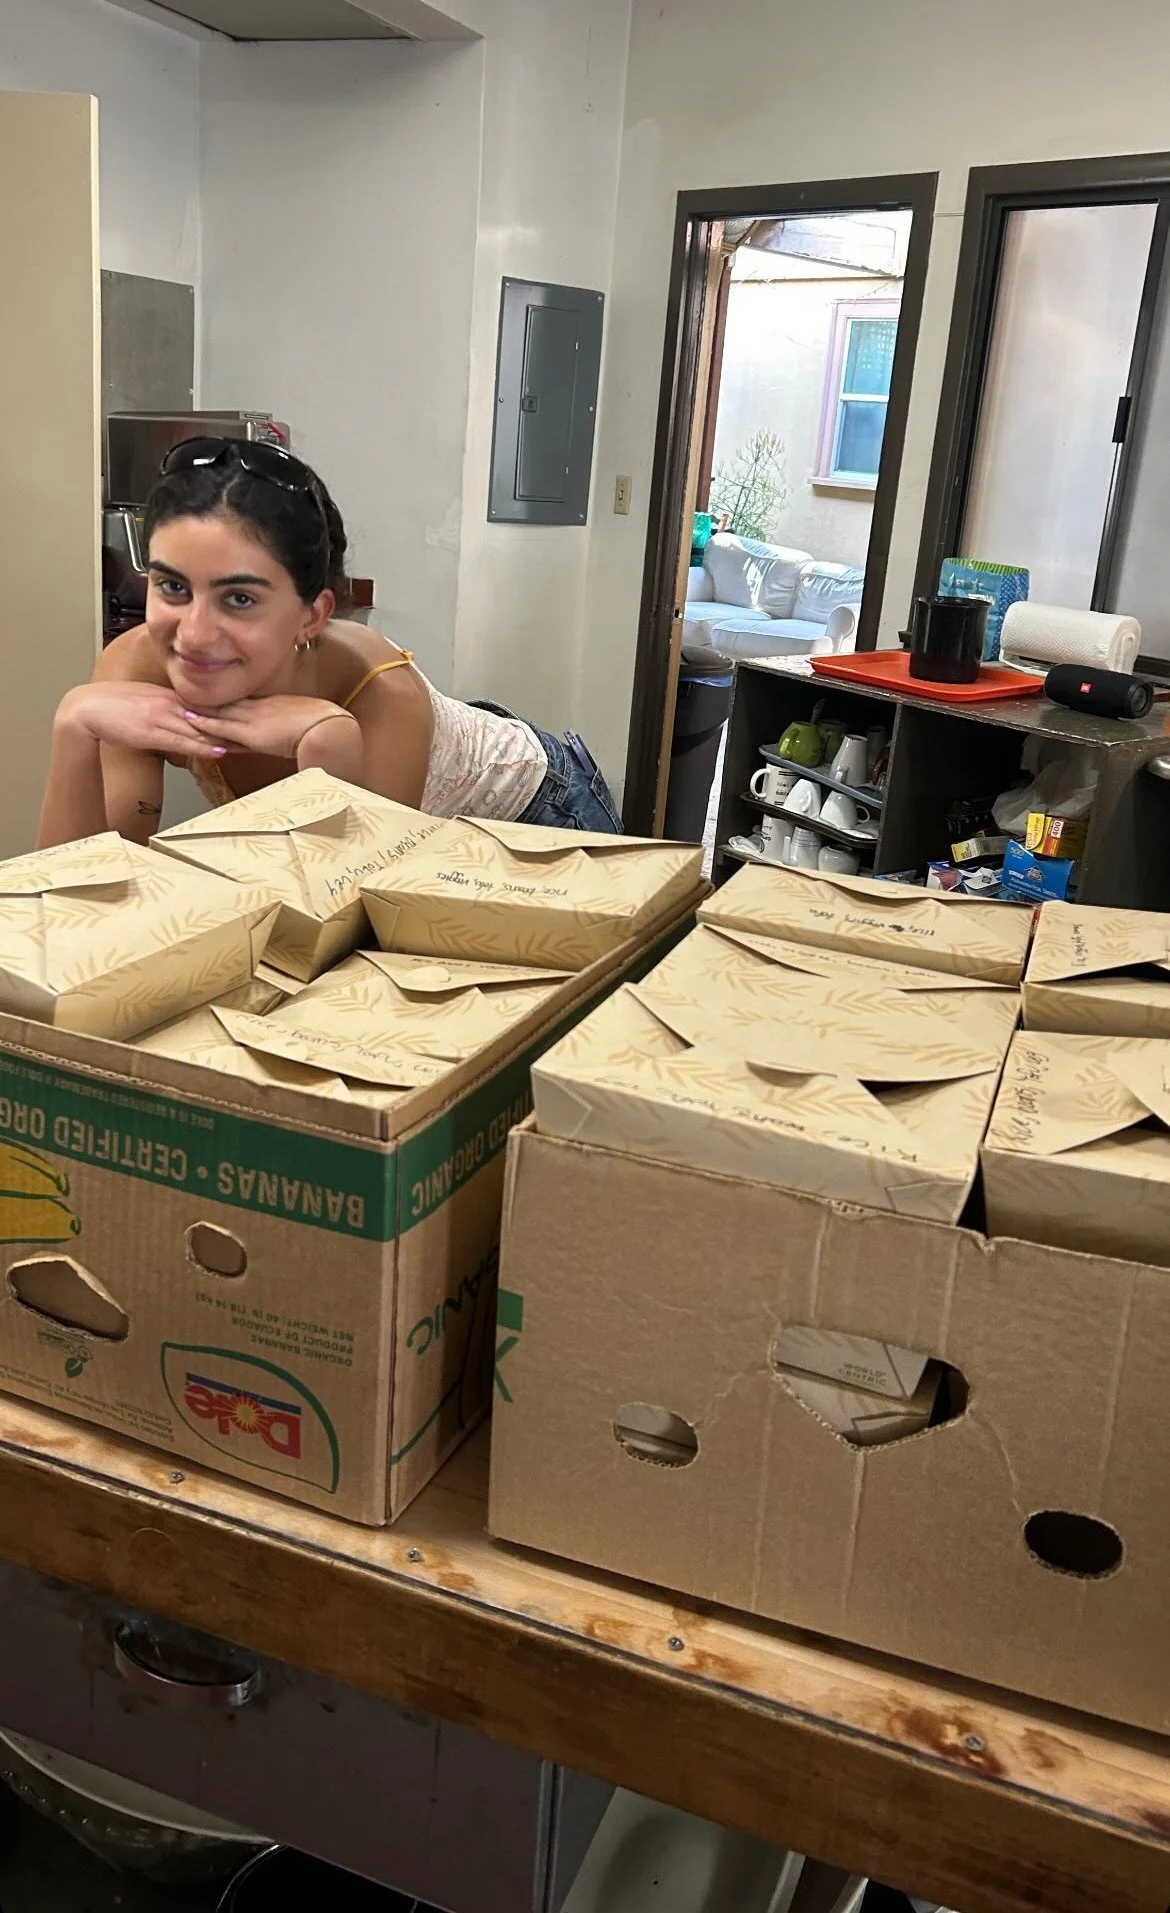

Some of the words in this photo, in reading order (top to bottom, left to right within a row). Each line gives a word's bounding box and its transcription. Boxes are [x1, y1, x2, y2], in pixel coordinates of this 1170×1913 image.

[1052, 821, 1062, 837] 400
[52, 1115, 188, 1181] CERTIFIED
[411, 1131, 485, 1216] ORGANIC
[216, 1161, 366, 1229] BANANAS
[231, 1316, 281, 1337] ECUADOR
[266, 1312, 280, 1323] 40
[251, 1333, 301, 1355] BANANAS
[285, 1331, 300, 1343] OF
[303, 1334, 354, 1355] PRODUCT
[332, 1329, 354, 1343] NET
[302, 1347, 354, 1368] ORGANIC
[184, 1384, 301, 1460] Dole
